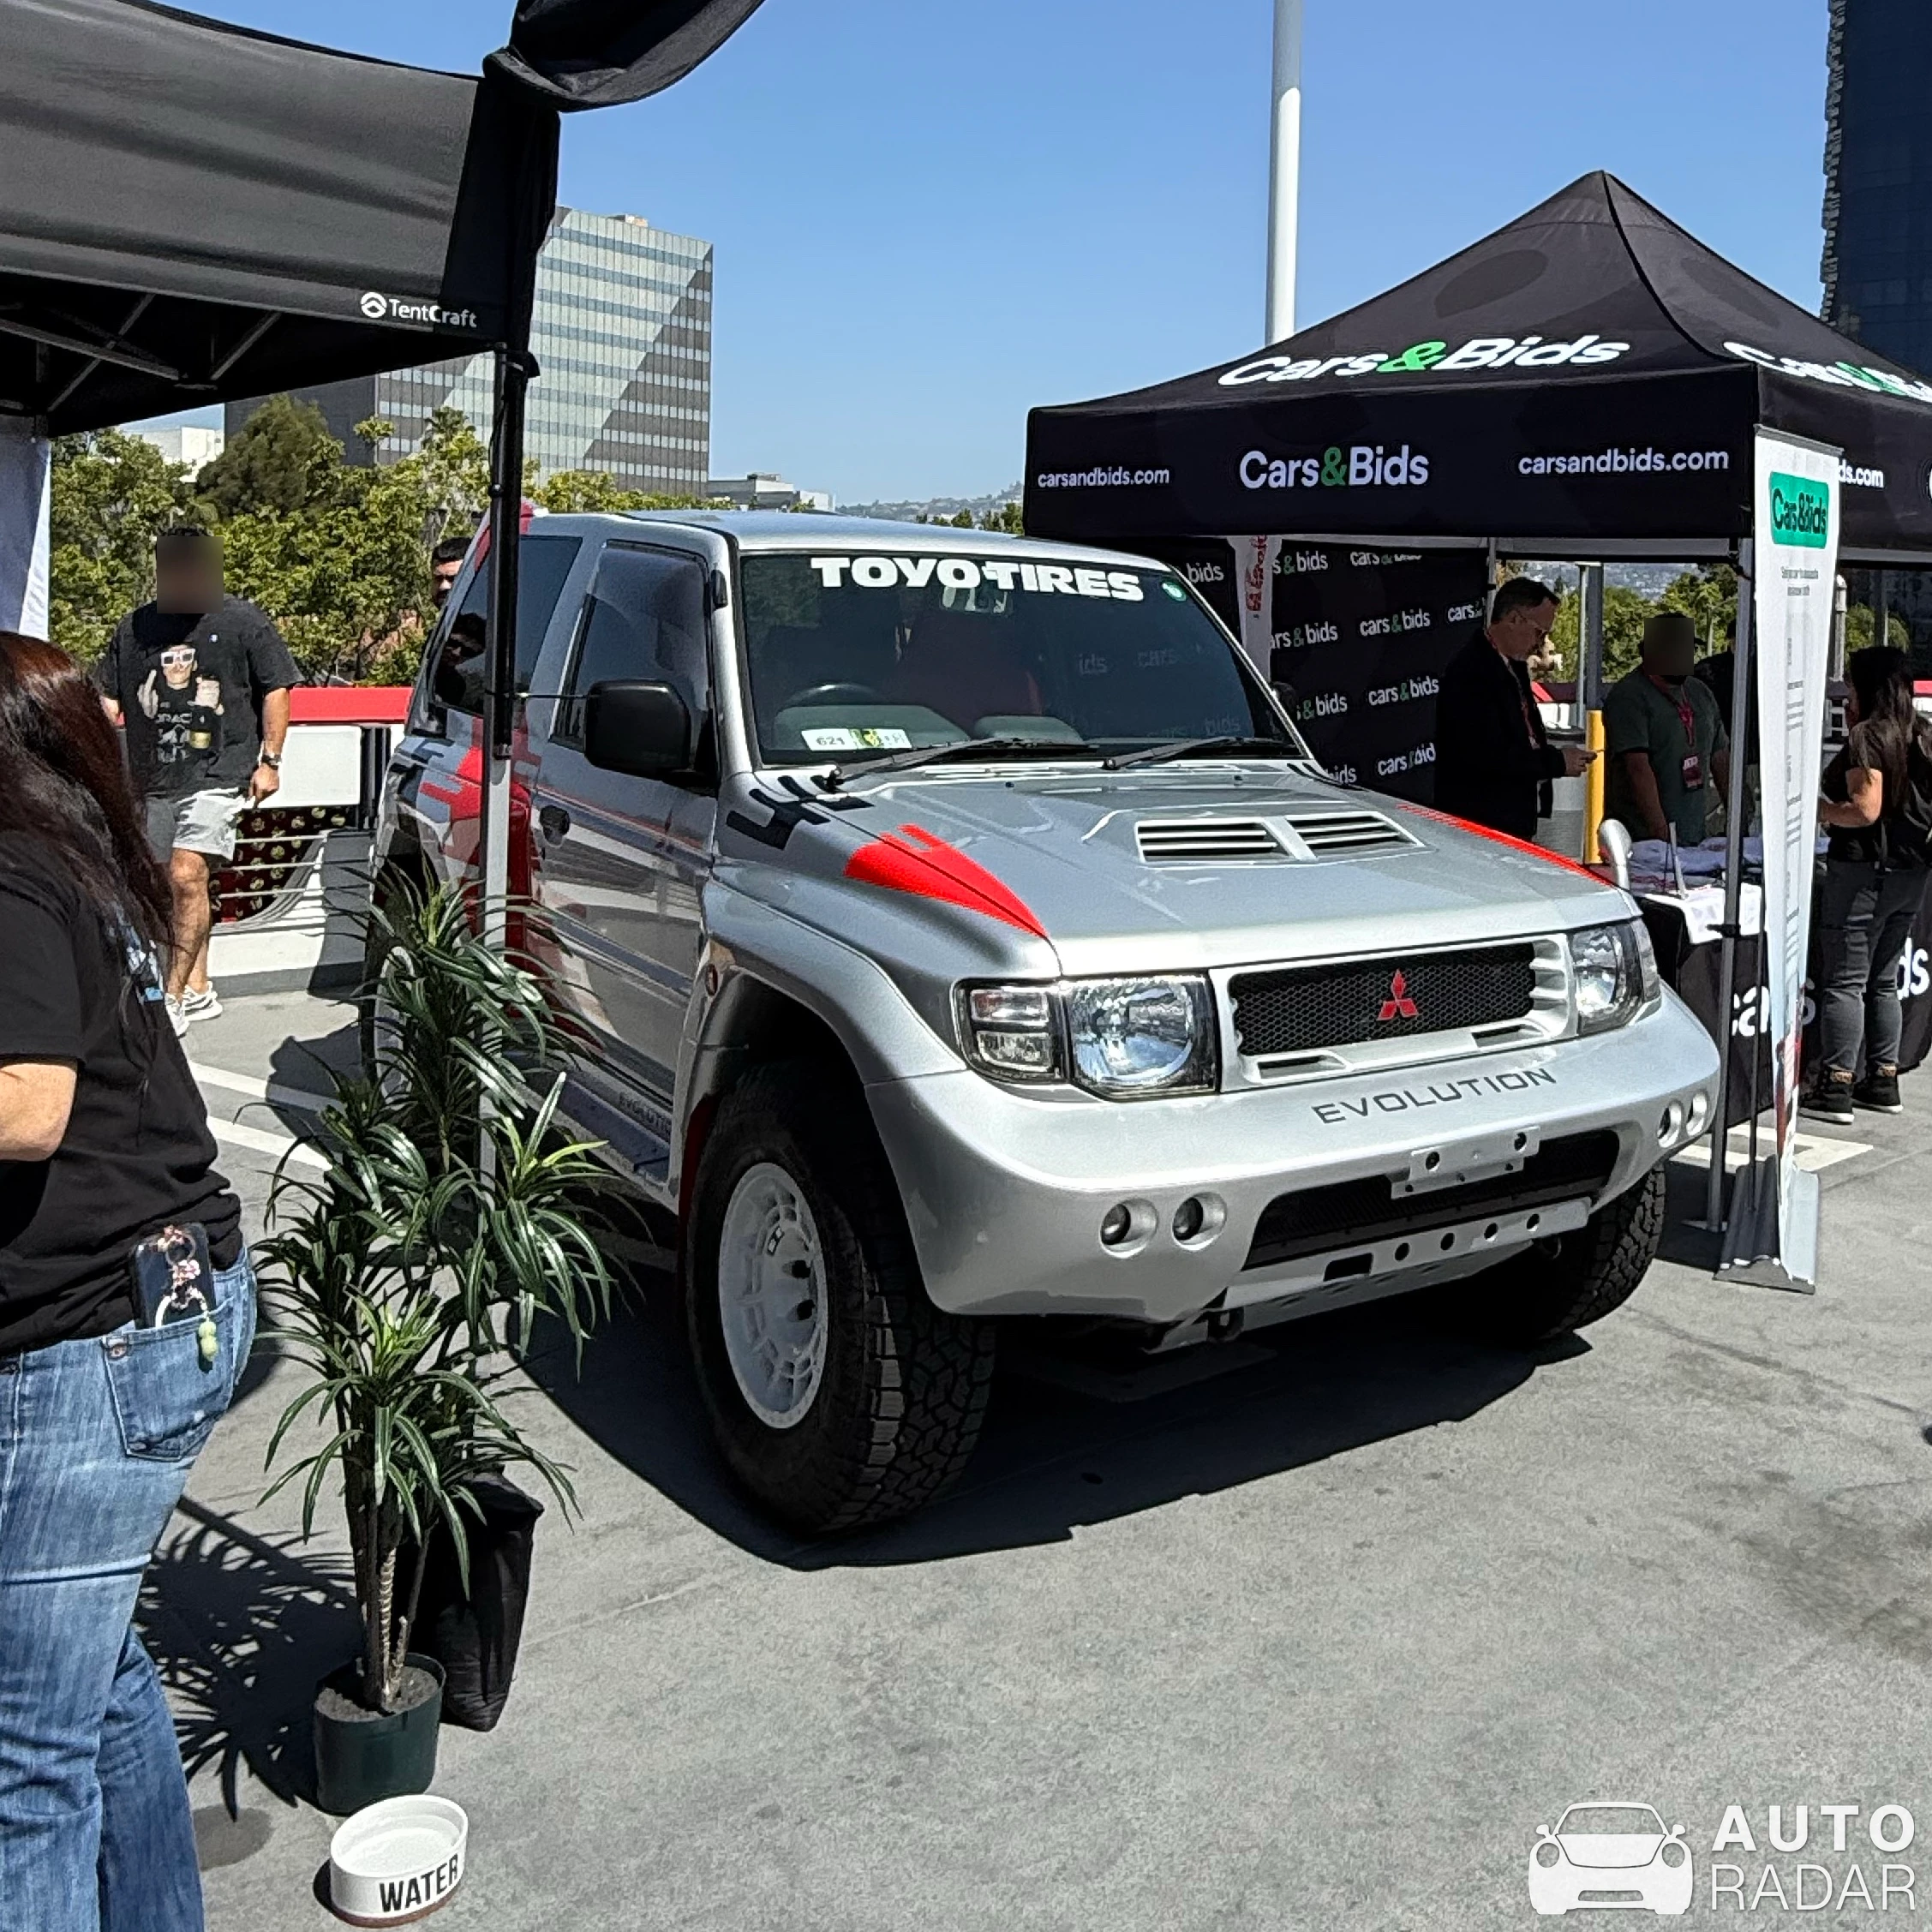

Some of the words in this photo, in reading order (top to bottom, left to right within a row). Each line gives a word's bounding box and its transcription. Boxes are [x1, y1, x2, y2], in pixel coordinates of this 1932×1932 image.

[388, 298, 477, 327] TentCraft
[1217, 335, 1630, 386] Cars&Bids
[1239, 445, 1430, 489] Cars&Bids
[1518, 447, 1730, 475] carsandbids.com
[1038, 466, 1170, 487] carsandbids.com
[1186, 562, 1224, 583] bids
[1295, 550, 1329, 572] bids
[810, 557, 981, 588] TOYO
[982, 561, 1144, 601] TIRES
[1305, 621, 1338, 643] bids
[1360, 618, 1390, 637] cars
[1402, 608, 1431, 630] bids
[1315, 692, 1348, 716] bids
[1368, 686, 1398, 705] cars
[1409, 675, 1439, 697] bids
[1378, 755, 1407, 775] cars
[1311, 1068, 1557, 1124] EVOLUTION
[379, 1852, 459, 1912] WATER
